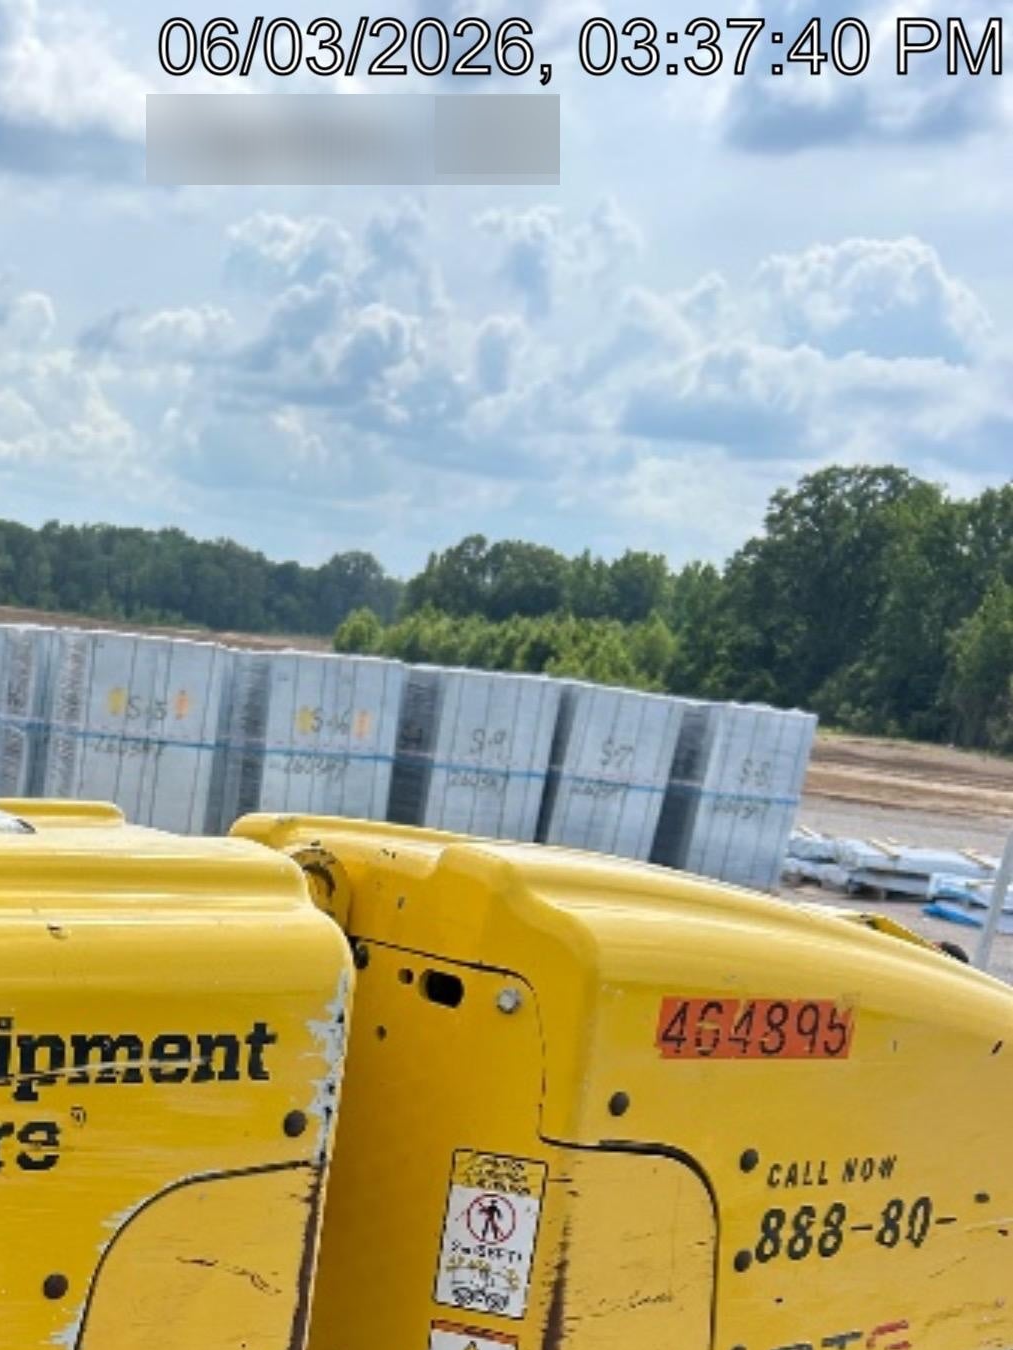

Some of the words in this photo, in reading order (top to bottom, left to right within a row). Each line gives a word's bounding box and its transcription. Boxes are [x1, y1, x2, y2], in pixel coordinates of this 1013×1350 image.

[660, 1000, 849, 1058] 464895
[767, 1160, 829, 1189] CALL
[842, 1154, 898, 1184] NOW
